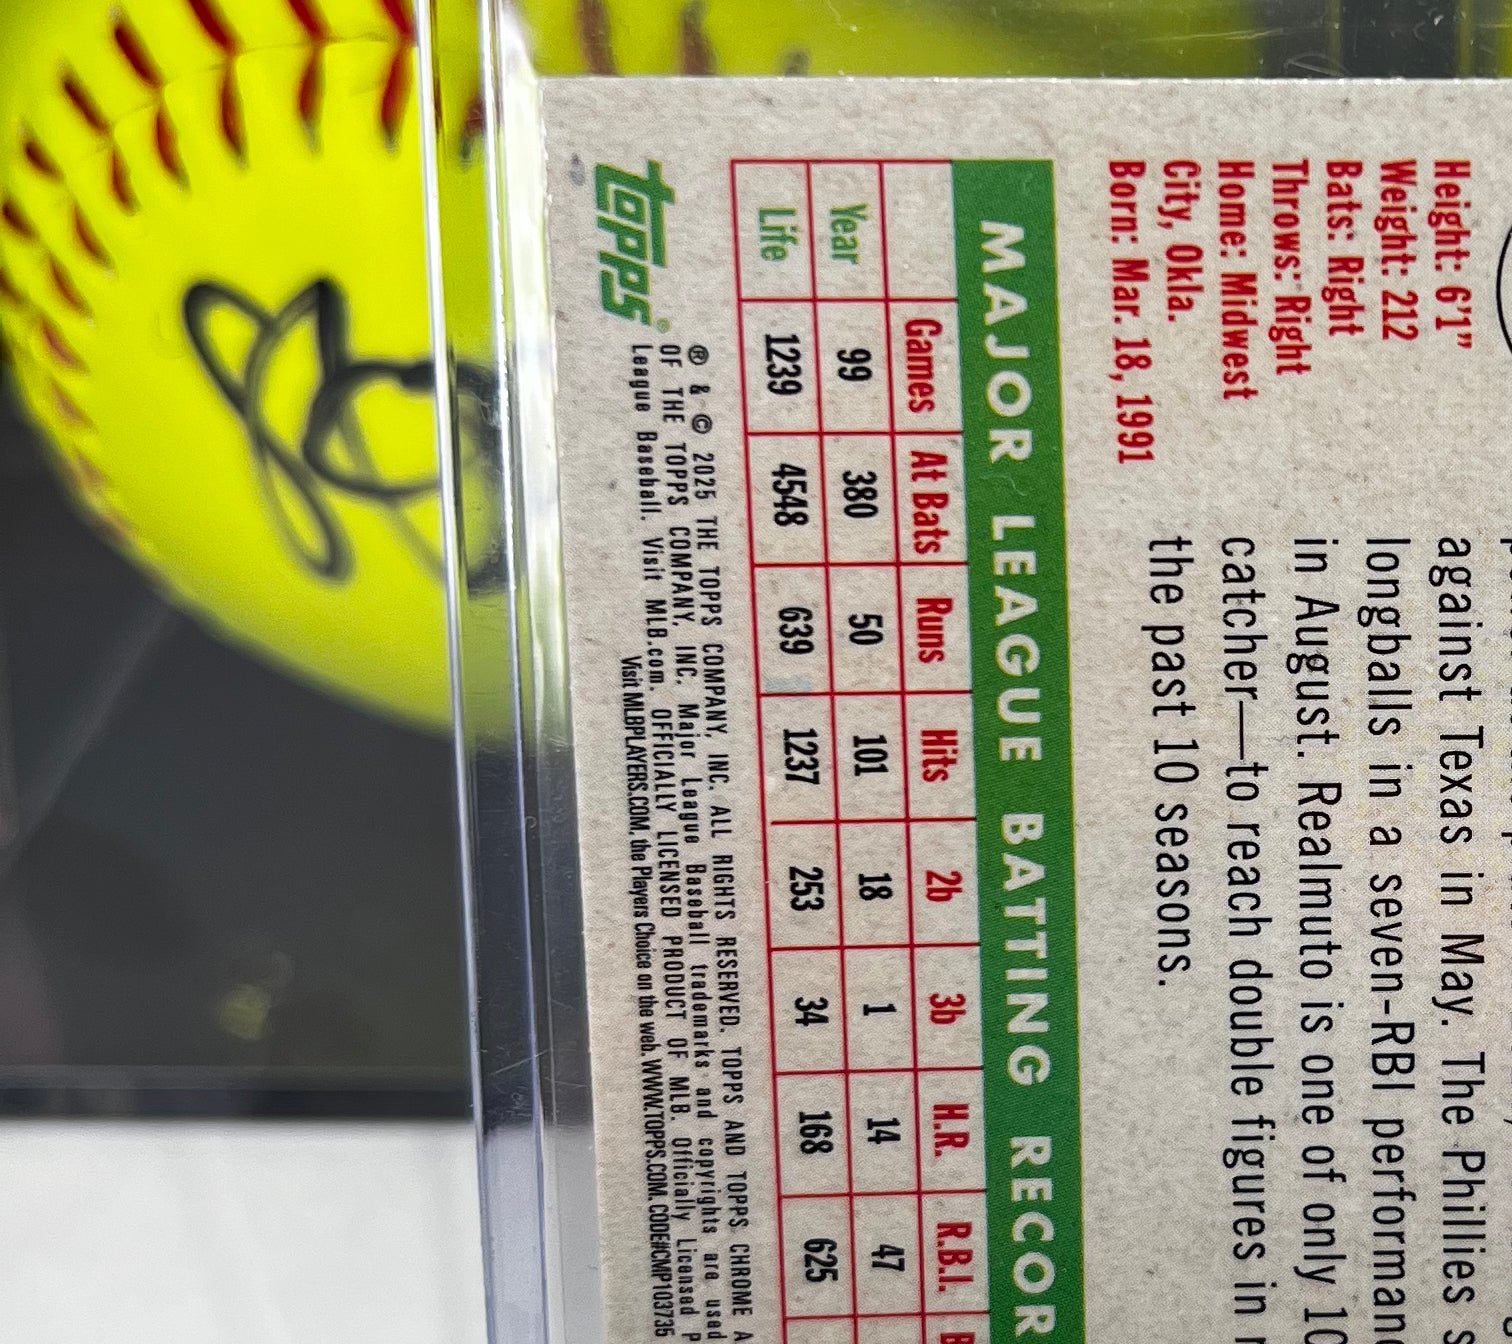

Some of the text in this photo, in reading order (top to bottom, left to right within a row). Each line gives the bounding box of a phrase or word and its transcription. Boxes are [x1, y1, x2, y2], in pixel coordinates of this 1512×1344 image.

[756, 208, 798, 262] Life
[828, 204, 867, 265] Year
[1156, 160, 1205, 322] City, Okla.
[1426, 160, 1472, 272] Height:
[1266, 159, 1313, 376] Throws: Right
[1319, 161, 1366, 337] Bats: Right
[1372, 159, 1419, 341] Weight: 212
[1217, 161, 1259, 400] Home: Midwest
[1107, 160, 1155, 465] Born: Mar. 18, 1991
[763, 333, 803, 396] 1239
[835, 348, 873, 382] 99
[903, 318, 943, 414] Games
[979, 220, 1033, 464] MAJOR
[691, 452, 717, 500] 2025
[841, 470, 879, 519] 380
[909, 450, 948, 482] At
[770, 463, 809, 527] 4548
[910, 492, 950, 555] Bats
[695, 515, 719, 550] THE
[1292, 538, 1340, 573] in
[697, 565, 723, 626] TOPPS
[1427, 537, 1484, 702] against
[777, 606, 815, 655] 639
[847, 613, 884, 646] 50
[914, 597, 954, 664] Runs
[991, 515, 1043, 761] LEAGUE
[619, 655, 644, 689] Visit
[1284, 594, 1340, 758] August.
[781, 728, 821, 785] 1237
[851, 734, 889, 777] 101
[919, 729, 959, 783] Hits
[1139, 535, 1200, 986] the past 10 seasons.
[1437, 725, 1485, 845] Texas
[628, 838, 652, 862] the
[708, 805, 733, 839] ALL
[628, 866, 654, 918] Players
[710, 854, 736, 920] RIGHTS
[788, 866, 825, 912] 253
[857, 872, 894, 902] 18
[924, 870, 963, 903] 2b
[1296, 782, 1343, 980] Realmuto
[1439, 872, 1485, 906] in
[632, 922, 657, 969] Choice
[1000, 813, 1052, 1086] BATTING
[635, 973, 653, 991] on
[636, 994, 660, 1018] the
[1430, 934, 1485, 1026] May.
[793, 996, 829, 1027] 34
[861, 1003, 897, 1017] 1
[927, 993, 967, 1025] 3b
[1299, 1001, 1345, 1034] is
[719, 1046, 744, 1104] TOPPS
[1299, 1054, 1335, 1125] one
[1440, 1051, 1486, 1125] The
[723, 1119, 746, 1156] AND
[797, 1110, 834, 1155] 168
[865, 1117, 901, 1145] 14
[931, 1103, 970, 1158] H.R.
[1300, 1145, 1347, 1183] of
[725, 1170, 749, 1228] TOPPS
[1440, 1143, 1487, 1304] Phillies
[646, 1204, 676, 1340] CODE#CMP103735
[802, 1238, 839, 1283] 625
[869, 1244, 906, 1272] 47
[934, 1222, 974, 1293] R.B.I.
[1291, 1202, 1347, 1285] only
[728, 1243, 753, 1317] CHROME
